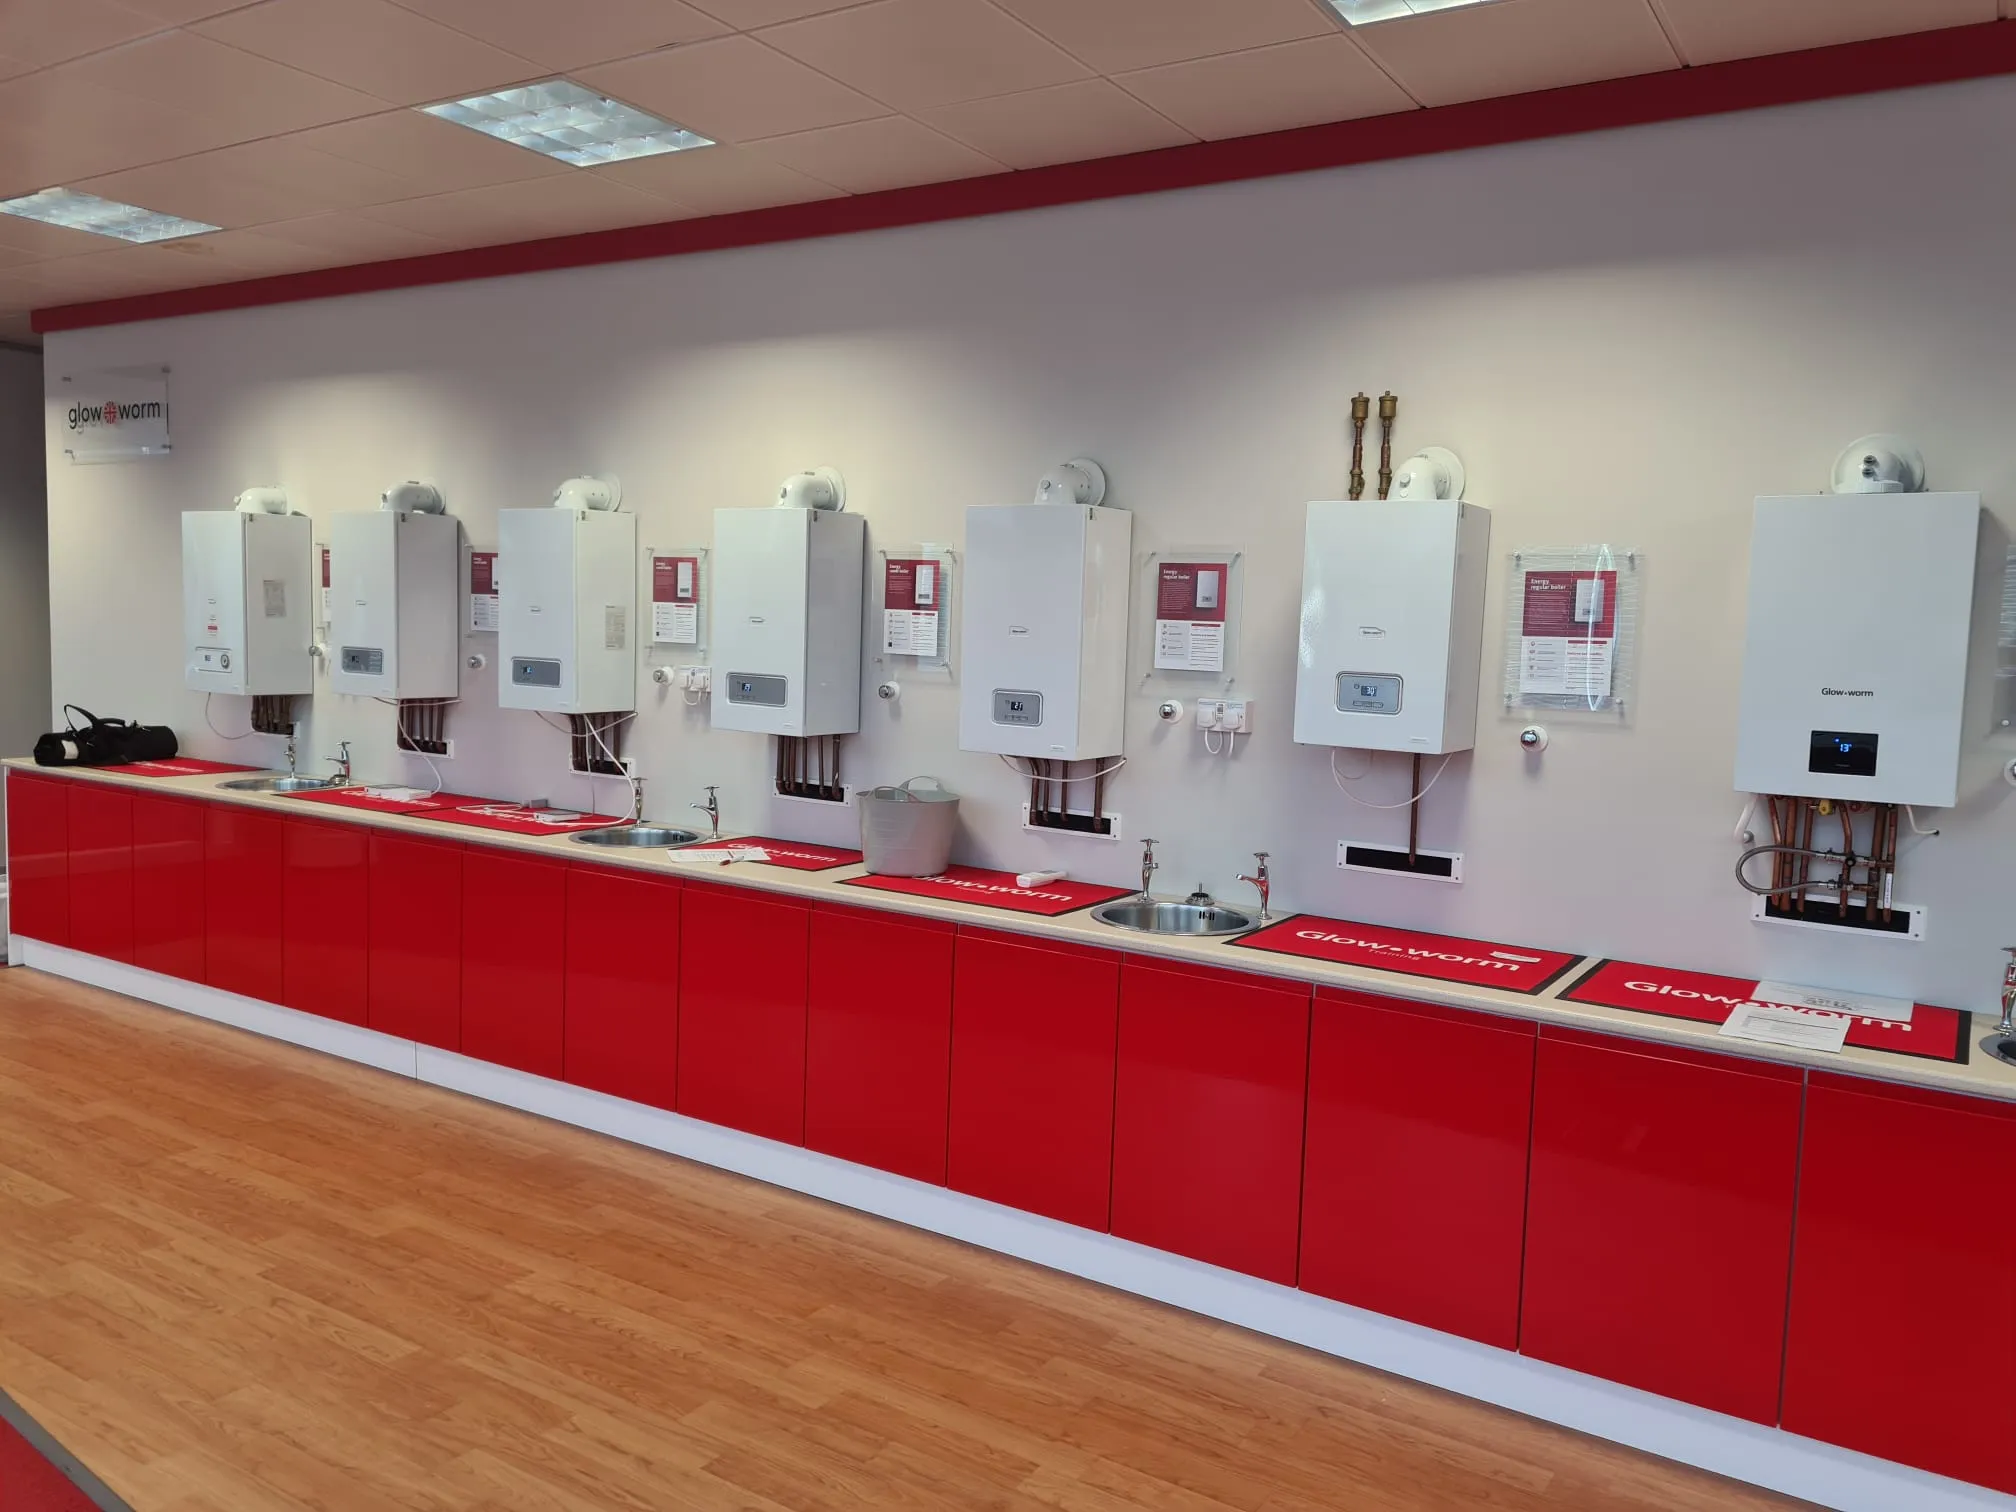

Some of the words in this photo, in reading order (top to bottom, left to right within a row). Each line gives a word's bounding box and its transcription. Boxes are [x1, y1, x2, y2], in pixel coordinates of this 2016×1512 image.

[68, 401, 103, 430] glow
[118, 401, 161, 420] worm
[1530, 578, 1550, 586] Energy
